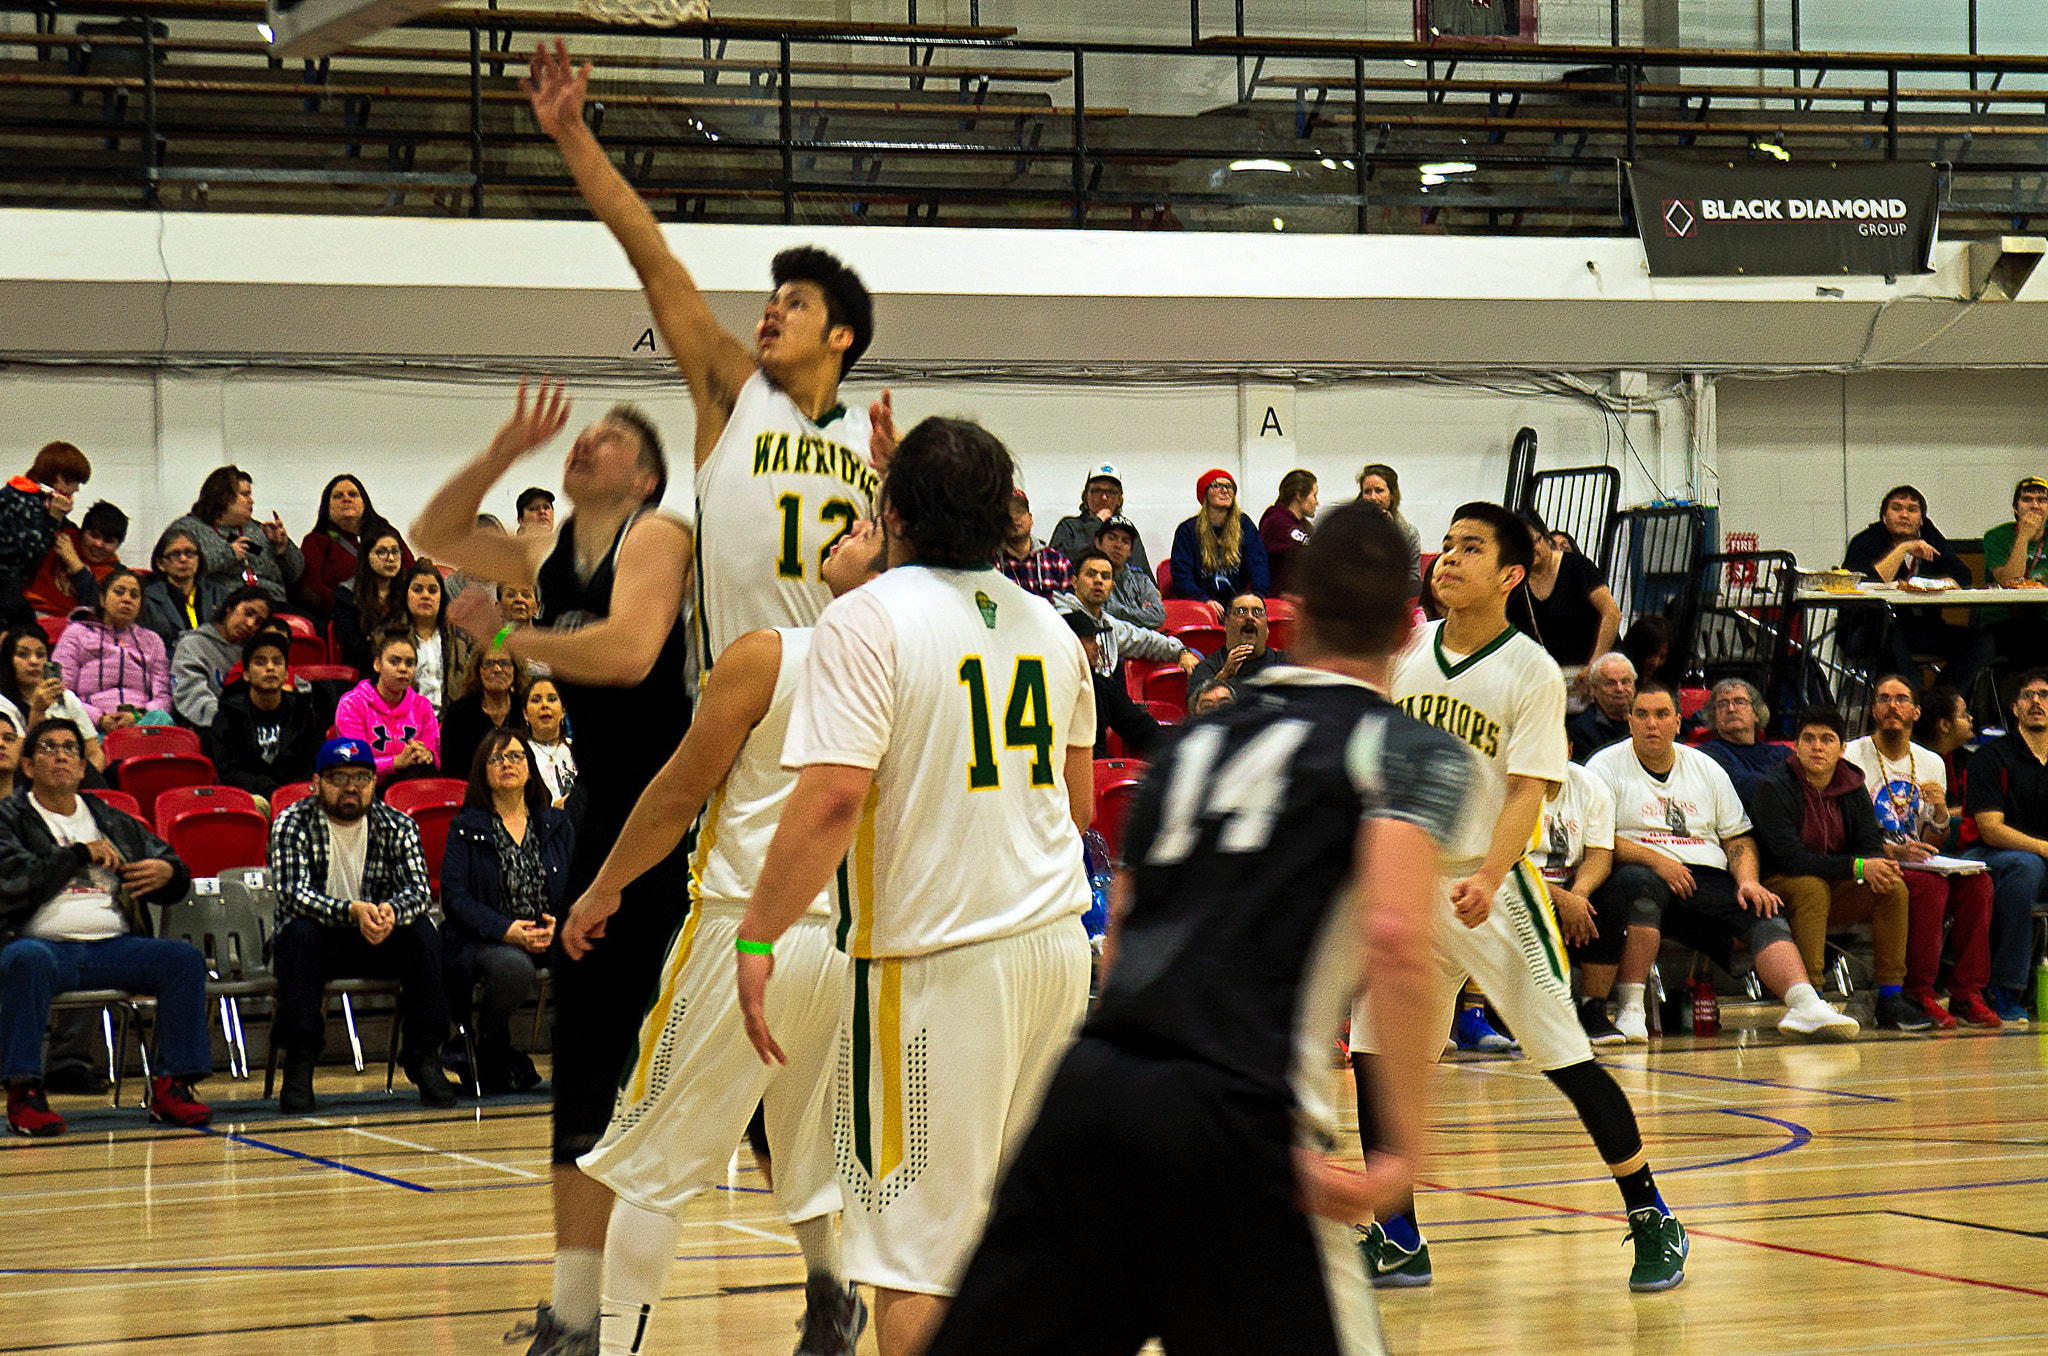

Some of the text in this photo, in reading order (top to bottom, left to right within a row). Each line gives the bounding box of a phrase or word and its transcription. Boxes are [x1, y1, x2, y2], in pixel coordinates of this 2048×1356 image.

[1701, 199, 1908, 220] BLACK DIAMOND
[1858, 223, 1908, 237] GROUP
[632, 327, 656, 352] A
[1260, 405, 1283, 437] A
[1731, 540, 1754, 551] FIRE
[957, 653, 1056, 793] 14
[1394, 692, 1501, 759] ARRIORS
[1144, 717, 1318, 867] 14
